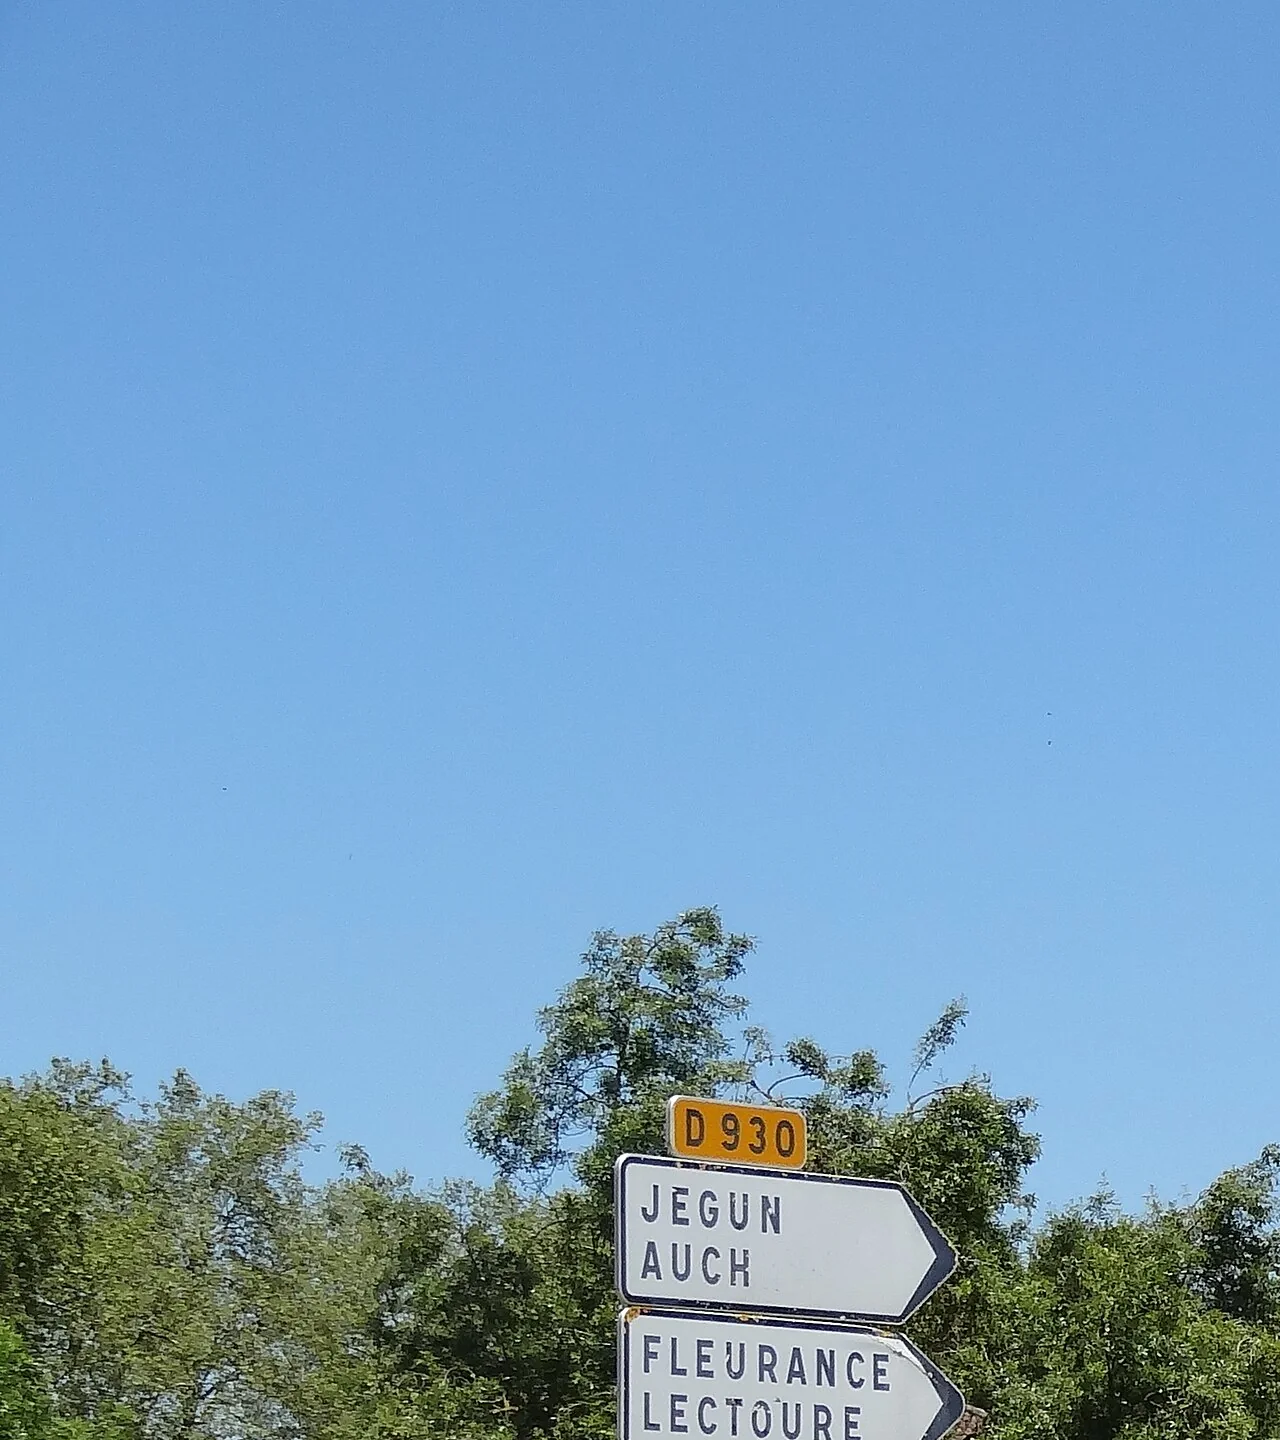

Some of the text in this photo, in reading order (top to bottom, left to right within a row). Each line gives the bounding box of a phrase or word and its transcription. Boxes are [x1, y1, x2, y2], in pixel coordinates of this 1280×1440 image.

[685, 1109, 797, 1159] D 930
[641, 1184, 782, 1235] JEGUN
[641, 1240, 751, 1288] AUCH
[643, 1335, 891, 1392] FLEURANCE
